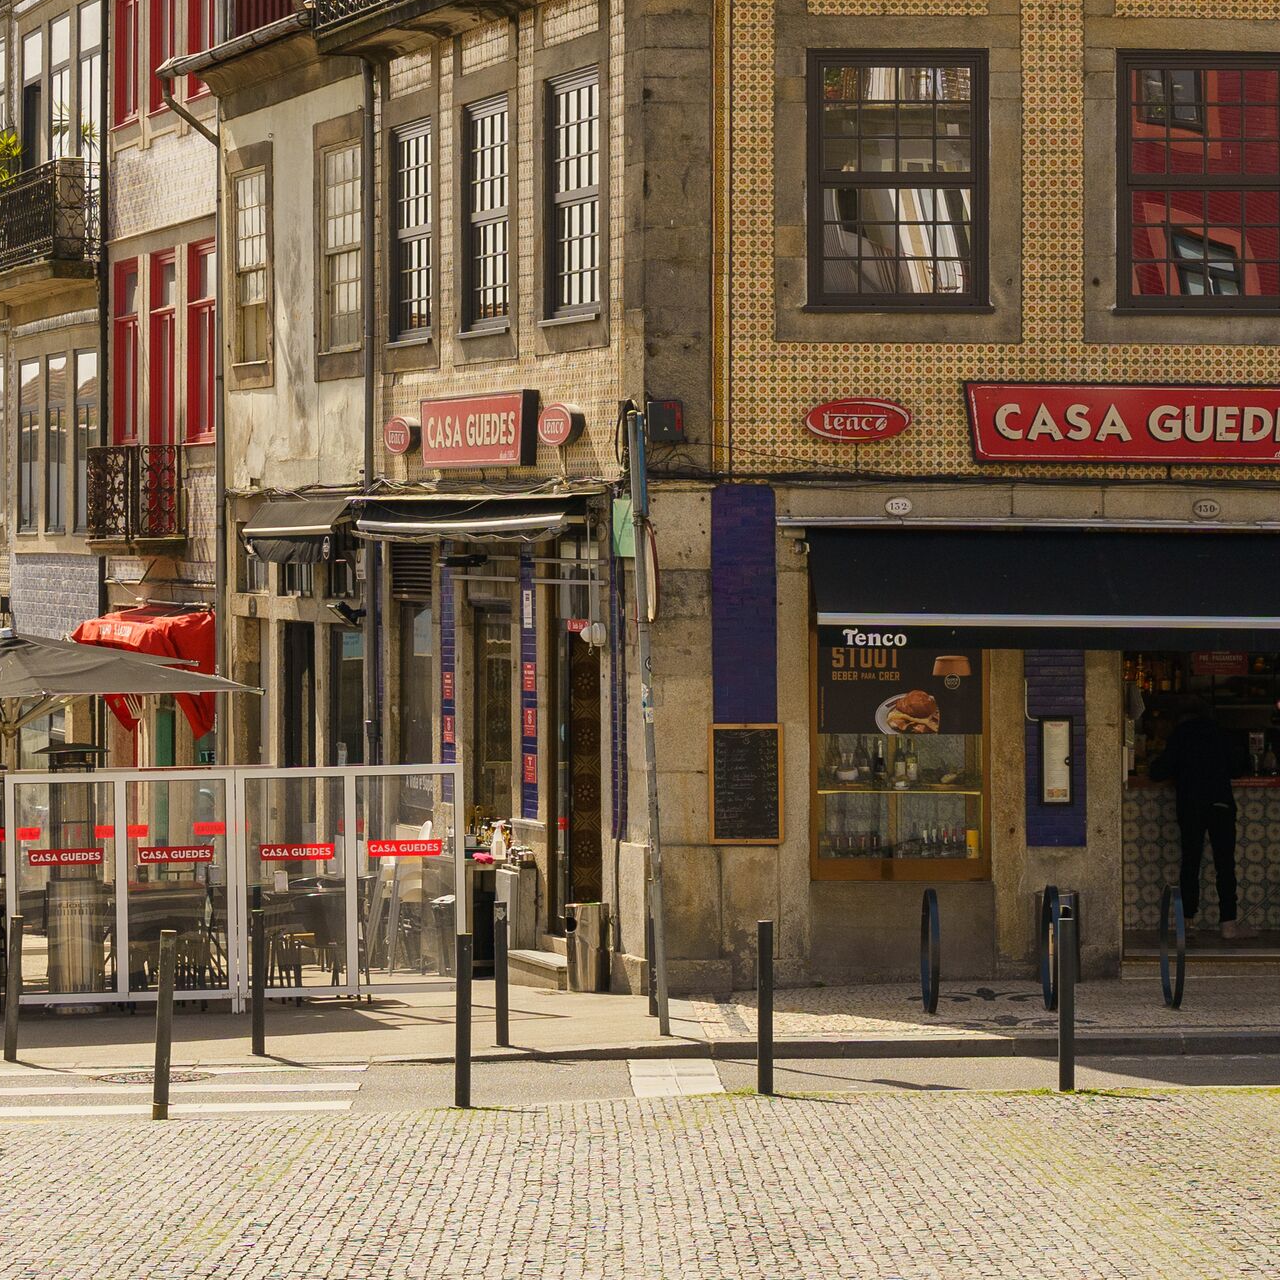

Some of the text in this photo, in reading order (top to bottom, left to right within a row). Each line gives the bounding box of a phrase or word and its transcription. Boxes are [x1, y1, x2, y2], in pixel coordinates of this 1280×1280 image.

[995, 402, 1132, 442] CASA
[427, 410, 516, 449] CASA GUEDES
[889, 502, 907, 511] 132
[1198, 504, 1216, 513] 130
[842, 628, 907, 646] Tenco
[831, 671, 900, 681] BEBER PARA CRER
[261, 847, 332, 857] CASA GUEDES
[370, 843, 440, 853] CASA GUEDES
[30, 852, 101, 863] CASA GUEDES
[141, 849, 211, 860] CASA GUEDES
